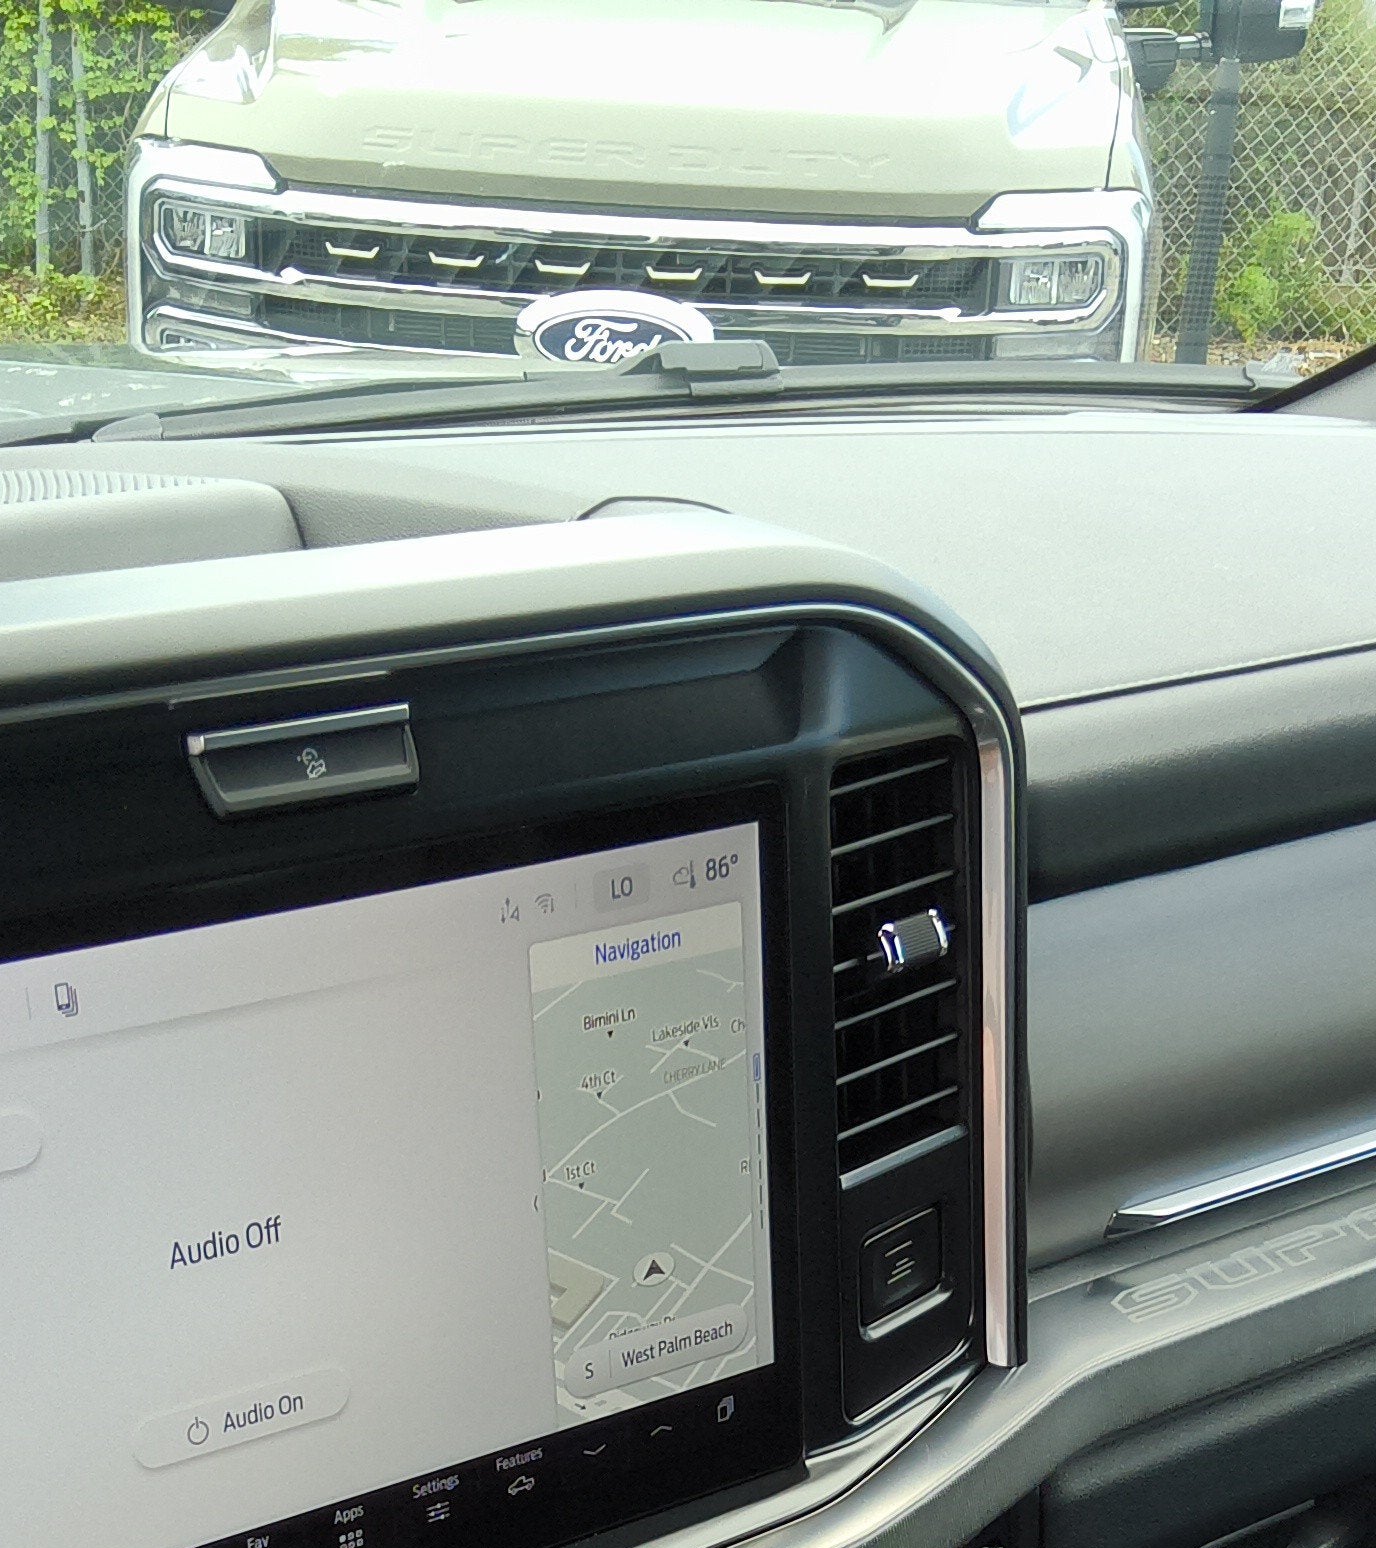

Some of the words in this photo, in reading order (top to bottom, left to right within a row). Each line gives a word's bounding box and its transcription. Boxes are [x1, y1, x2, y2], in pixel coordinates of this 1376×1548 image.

[363, 125, 645, 169] SUPER
[668, 143, 891, 179] DUTY
[610, 876, 633, 900] LO
[595, 930, 682, 965] Navigation
[583, 1012, 620, 1031] Bimini
[621, 1007, 636, 1021] Ln
[652, 1019, 701, 1043] Lakeside
[581, 1073, 602, 1089] 4th
[602, 1070, 616, 1084] Ct
[583, 1161, 596, 1177] Ct
[170, 1231, 240, 1270] Audio
[246, 1215, 282, 1249] Off
[622, 1344, 656, 1368] West
[658, 1335, 692, 1355] Palm
[694, 1321, 733, 1347] Beach
[223, 1403, 275, 1433] Audio
[278, 1394, 304, 1416] On
[495, 1446, 544, 1472] Features
[412, 1473, 460, 1499] Settings
[334, 1504, 364, 1525] Apps
